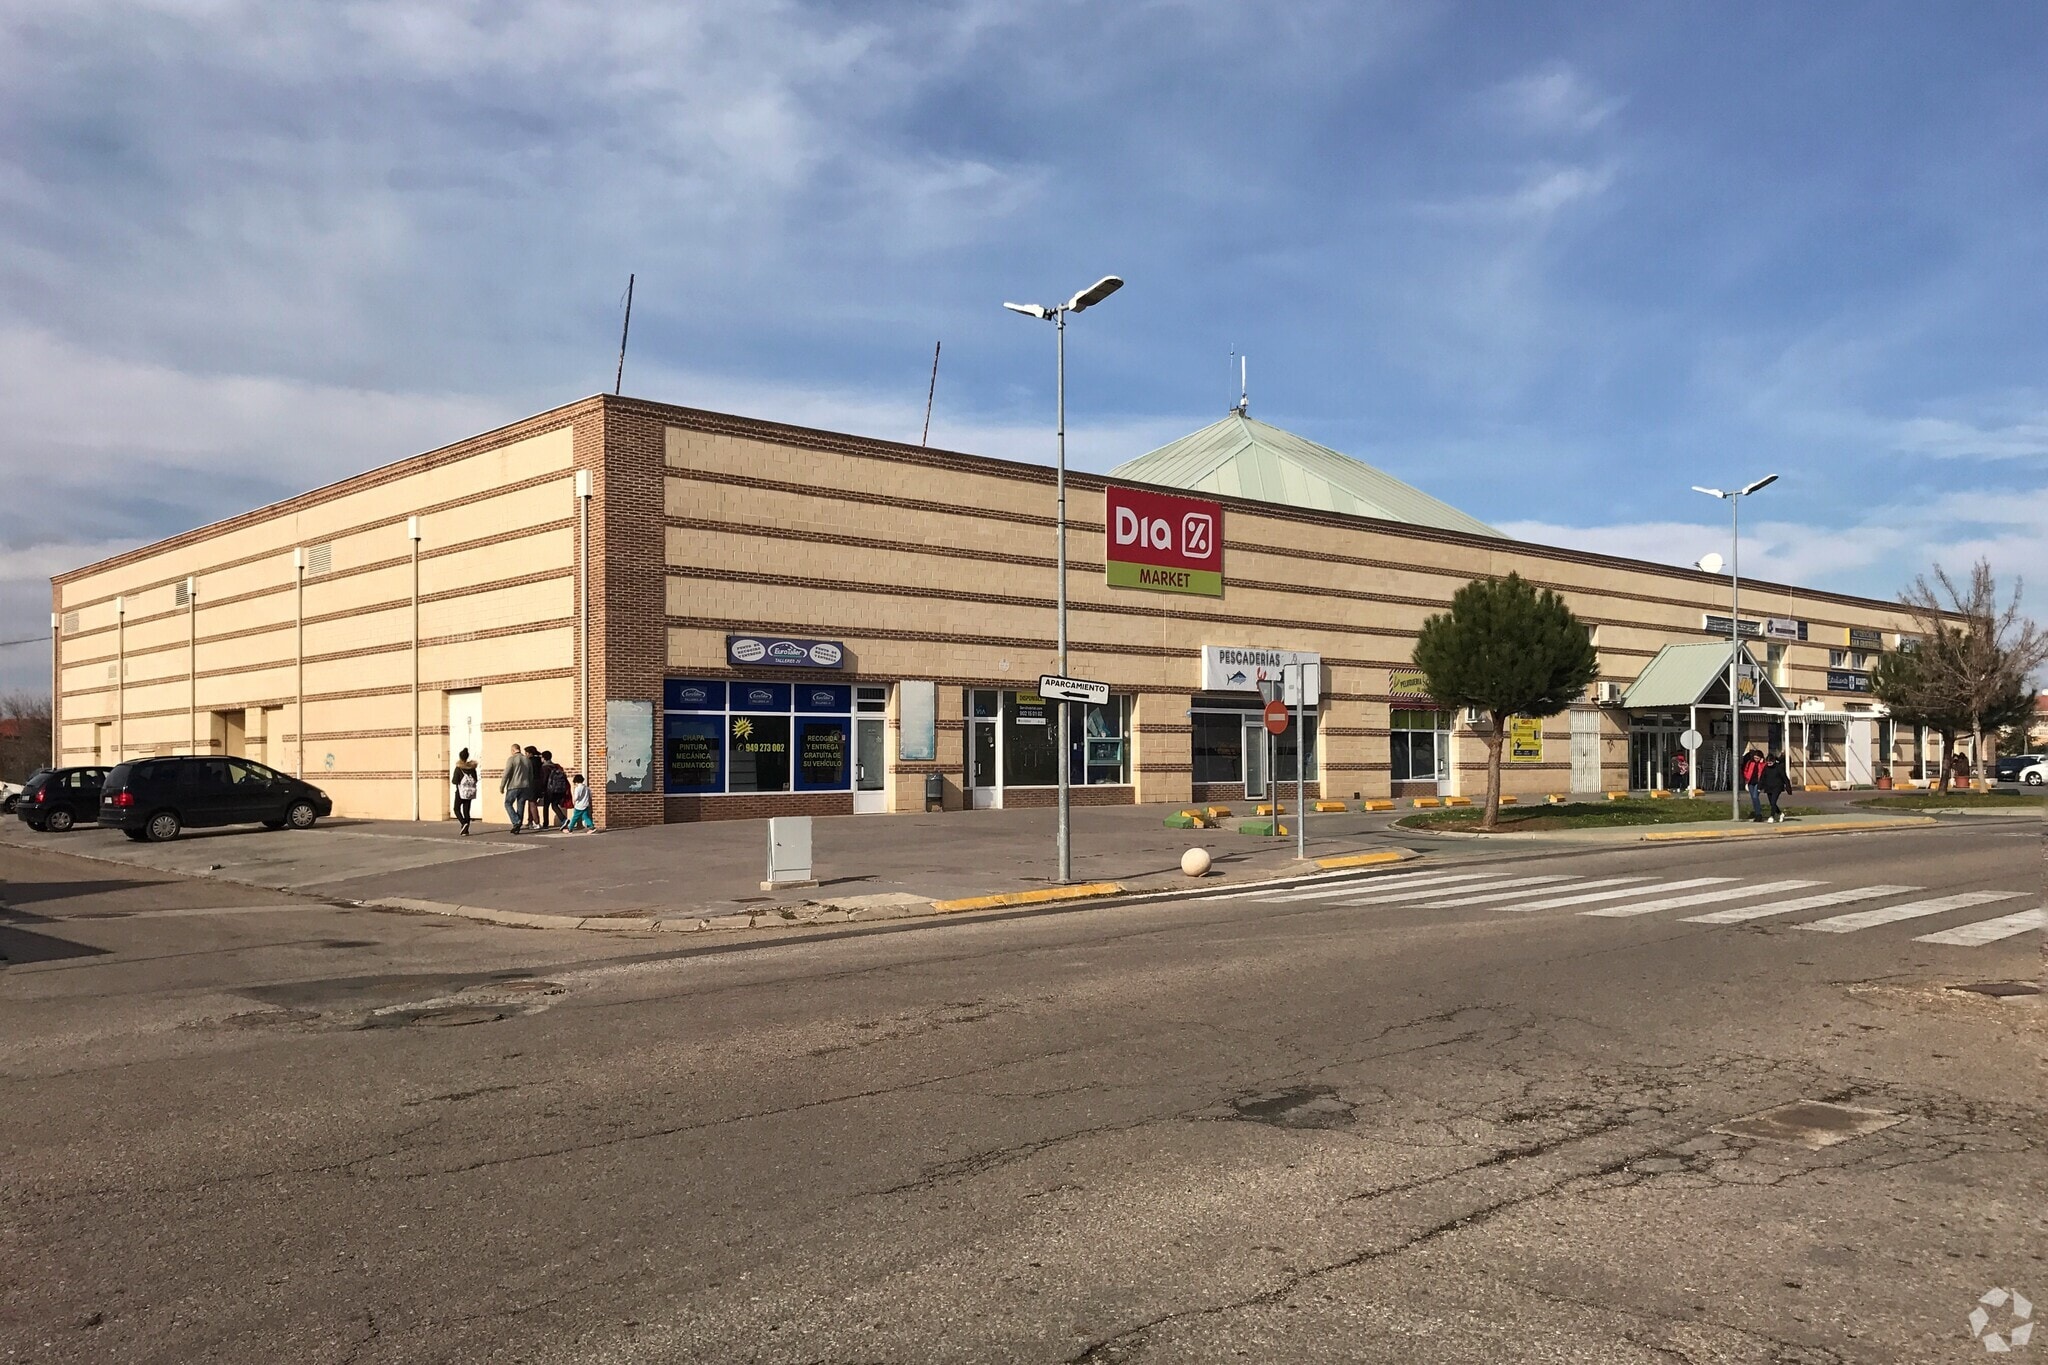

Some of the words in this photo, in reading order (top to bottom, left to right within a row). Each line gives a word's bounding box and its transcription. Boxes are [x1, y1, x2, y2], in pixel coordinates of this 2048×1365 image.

[1139, 568, 1191, 588] MARKET
[1219, 650, 1281, 668] PESCADERÍAS
[1045, 679, 1105, 692] APARCAMIENTO
[745, 743, 758, 752] 949
[759, 743, 772, 752] 273
[772, 743, 785, 752] 002
[676, 751, 711, 759] MECÁNICA
[671, 761, 715, 769] NEUMATICOS
[812, 759, 842, 767] VEHÍCULO
